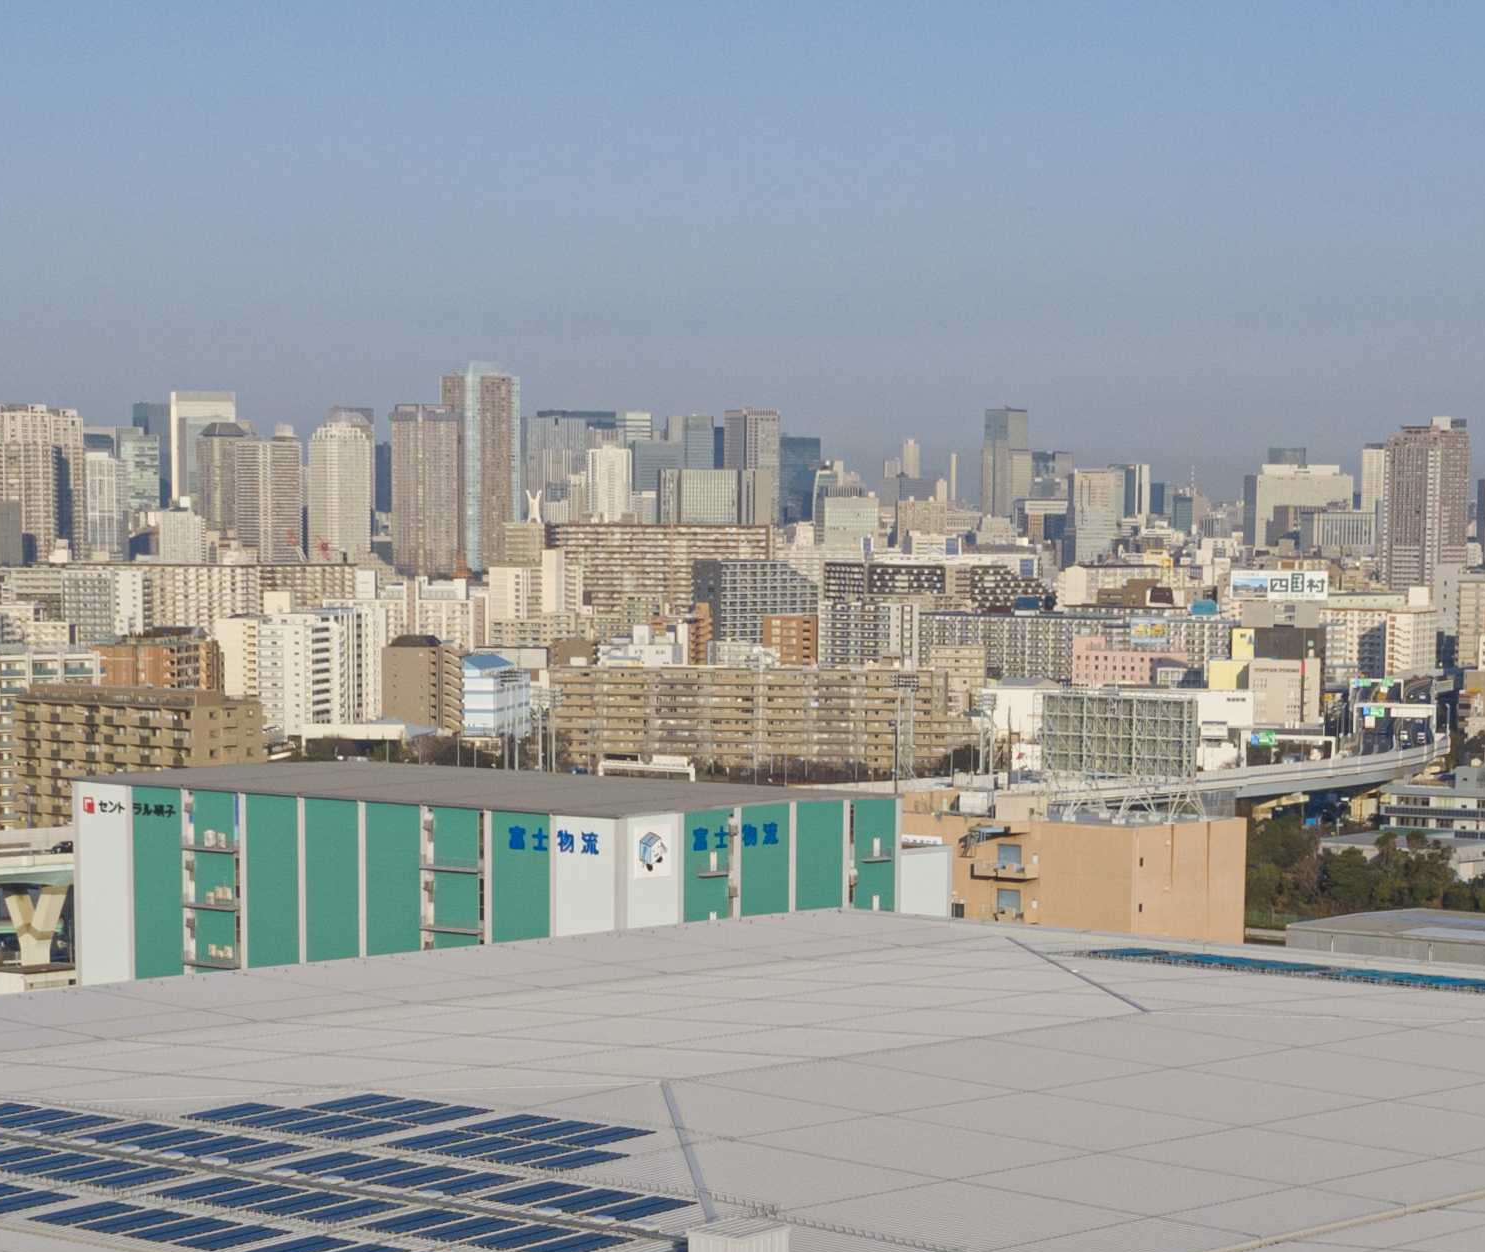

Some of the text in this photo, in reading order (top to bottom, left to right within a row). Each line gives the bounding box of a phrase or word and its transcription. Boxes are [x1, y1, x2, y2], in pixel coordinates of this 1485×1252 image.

[508, 826, 599, 855] 富士物流
[693, 822, 780, 851] 富士物流
